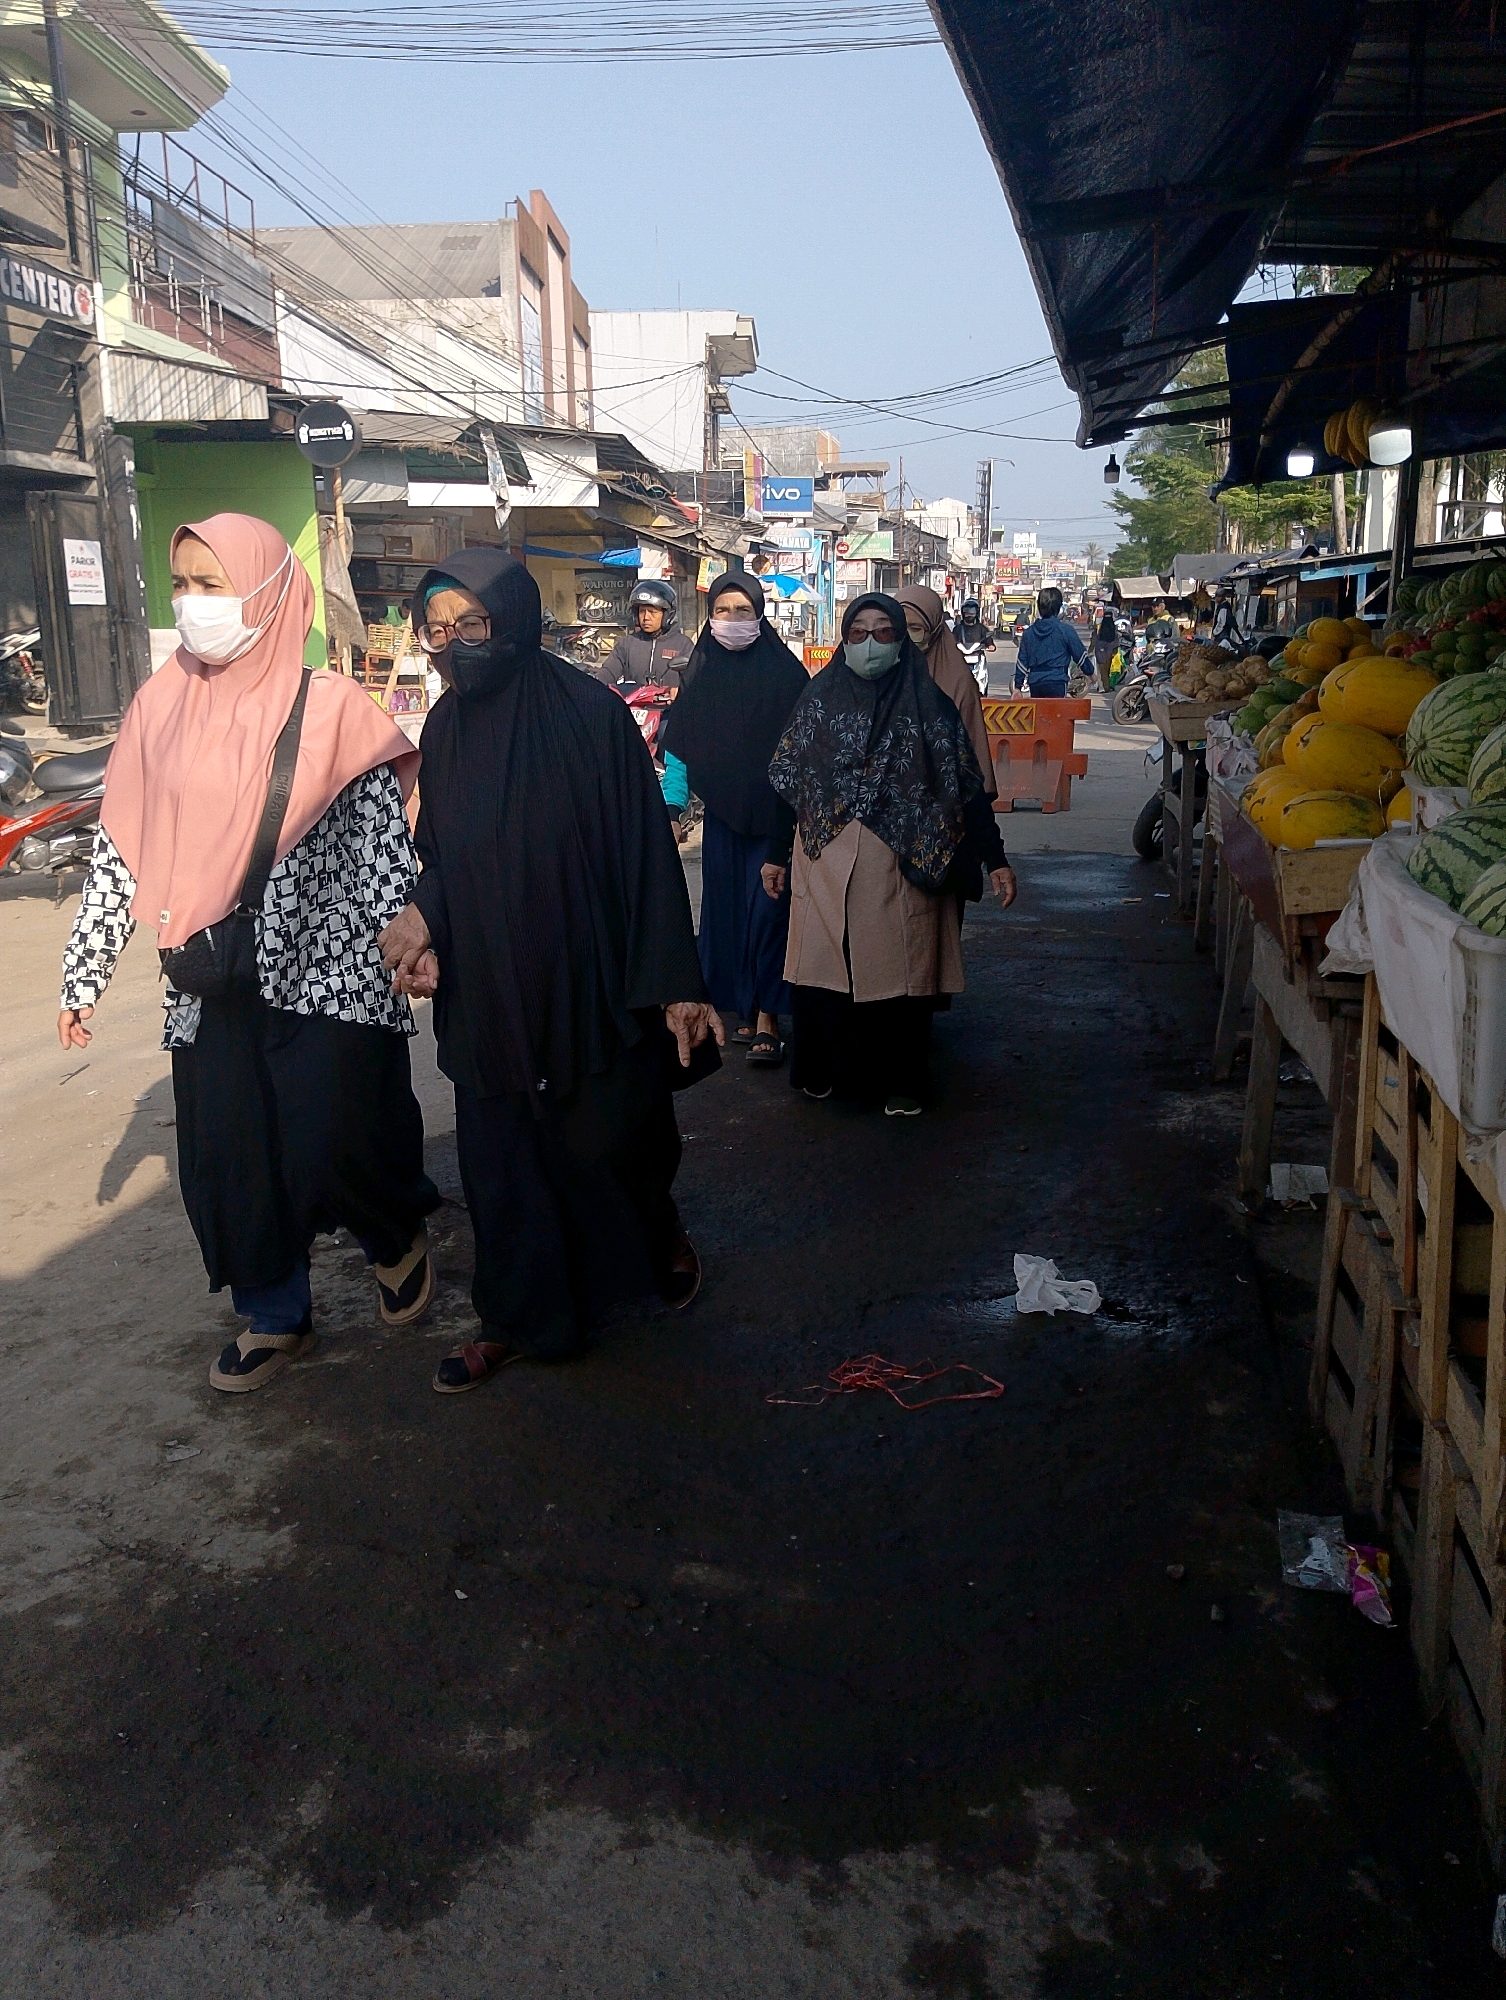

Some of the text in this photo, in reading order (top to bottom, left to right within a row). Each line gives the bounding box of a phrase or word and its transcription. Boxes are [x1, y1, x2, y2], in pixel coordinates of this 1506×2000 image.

[0, 258, 75, 317] CENTER
[70, 555, 96, 566] PARKIR
[582, 580, 625, 589] WARUNG
[269, 773, 289, 823] CHIBAO
